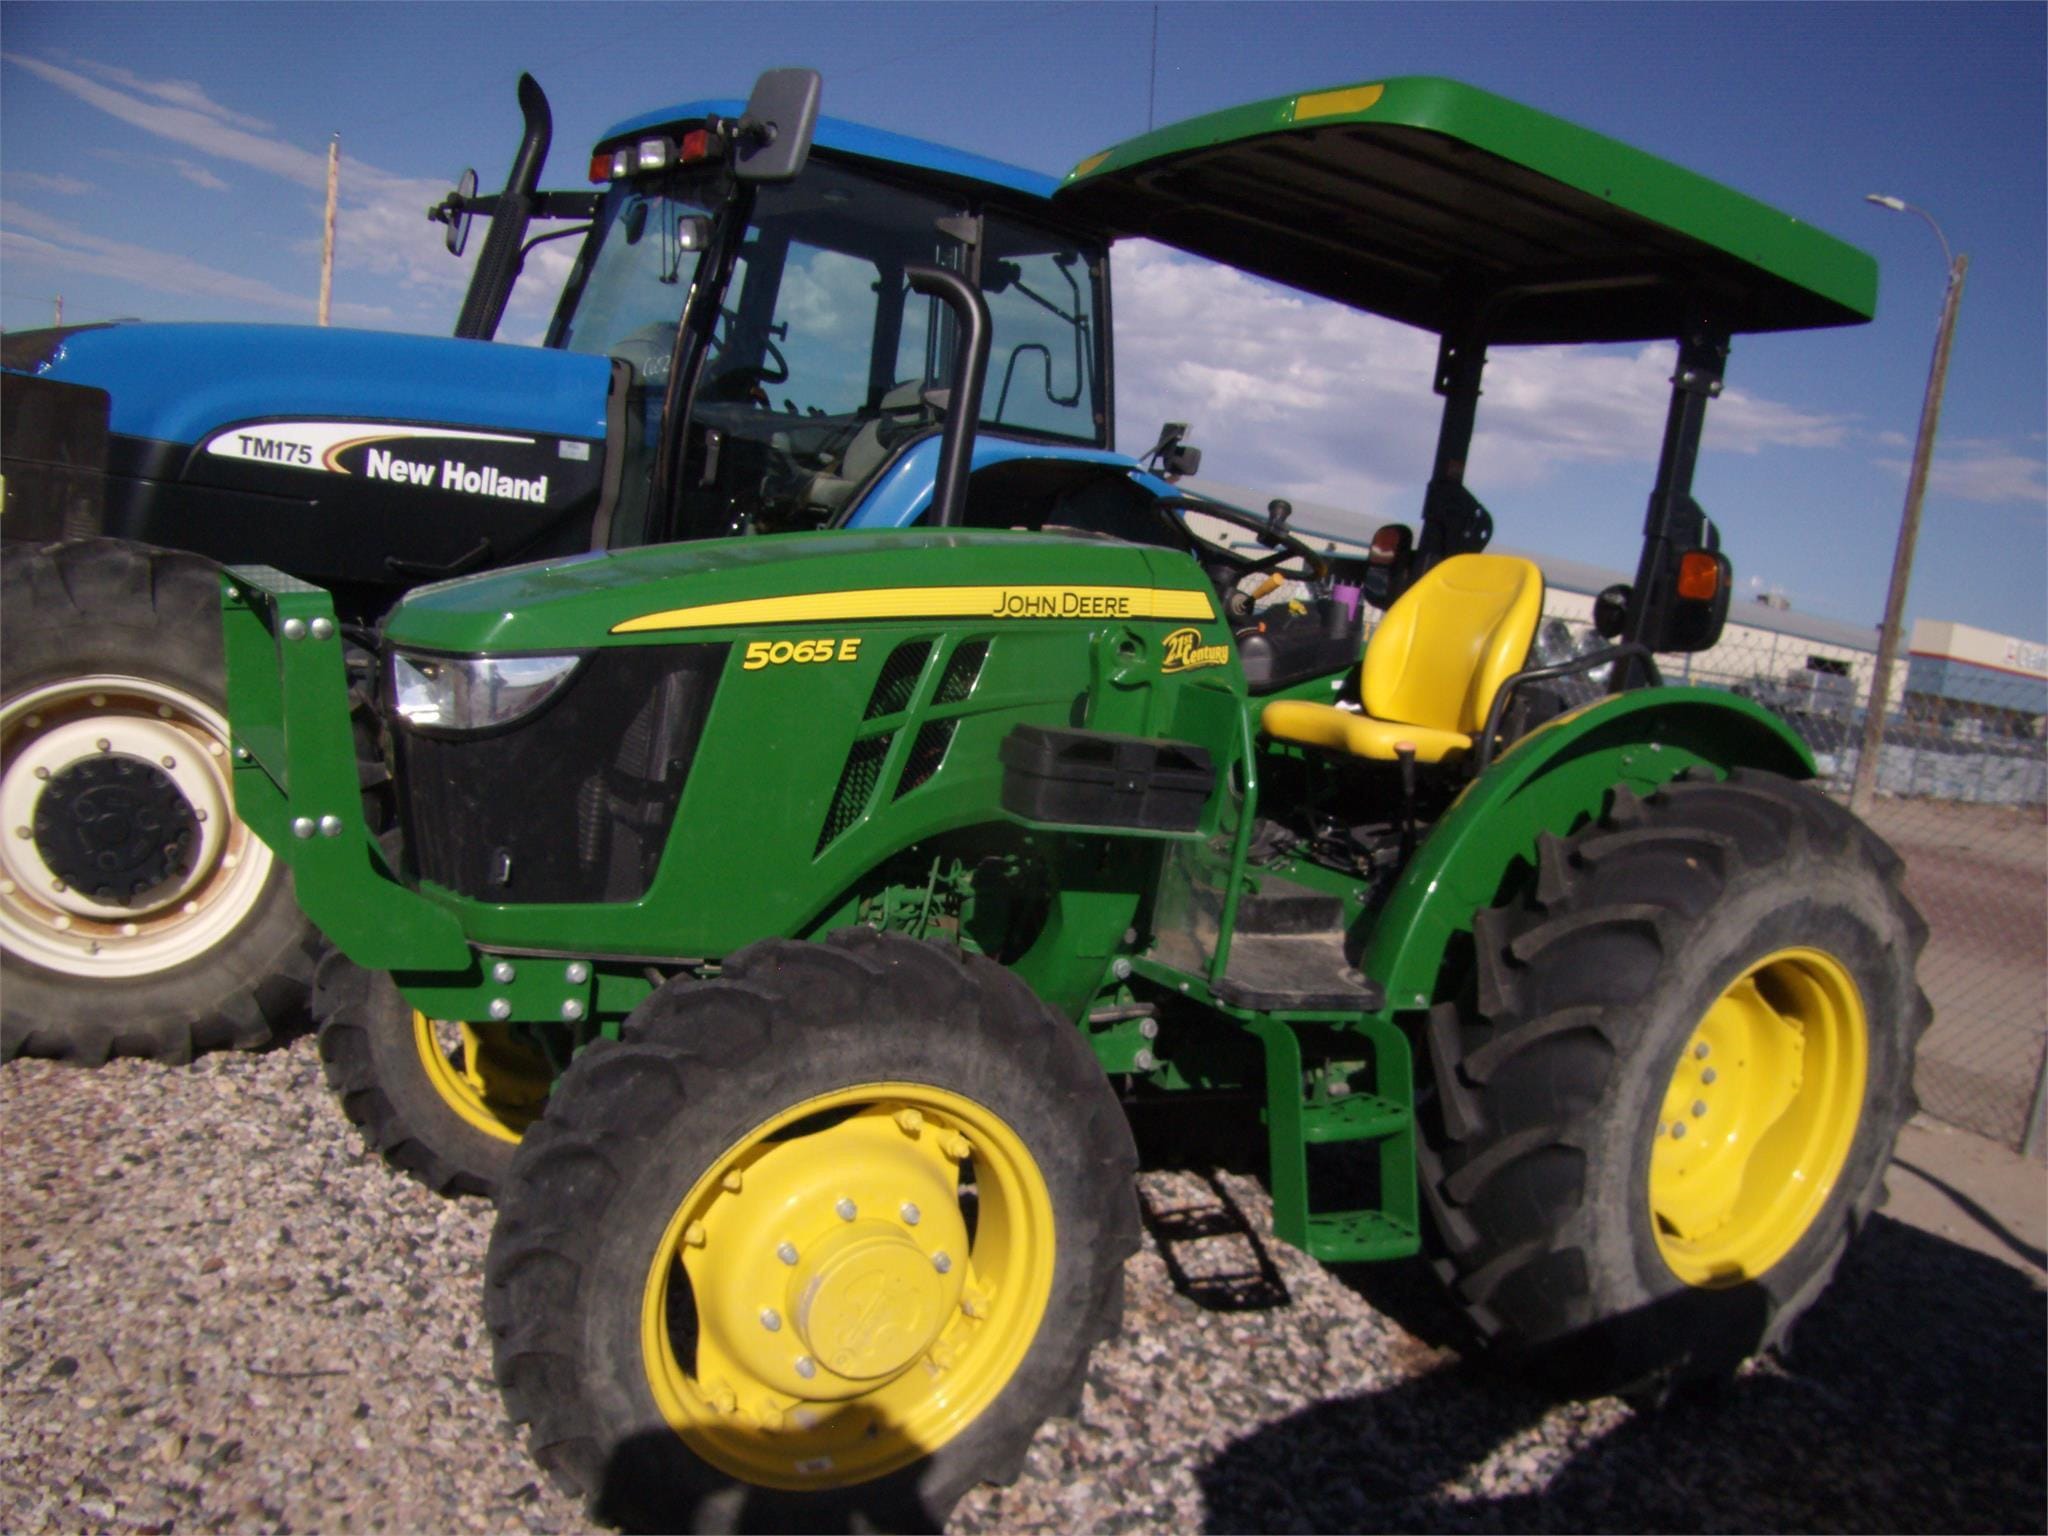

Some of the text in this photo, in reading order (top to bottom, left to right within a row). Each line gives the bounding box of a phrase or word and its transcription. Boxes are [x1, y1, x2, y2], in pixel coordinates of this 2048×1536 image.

[238, 434, 313, 465] TM175
[366, 448, 548, 503] New Holland
[993, 591, 1129, 614] JOHN DEERE
[743, 638, 861, 670] 5065 E
